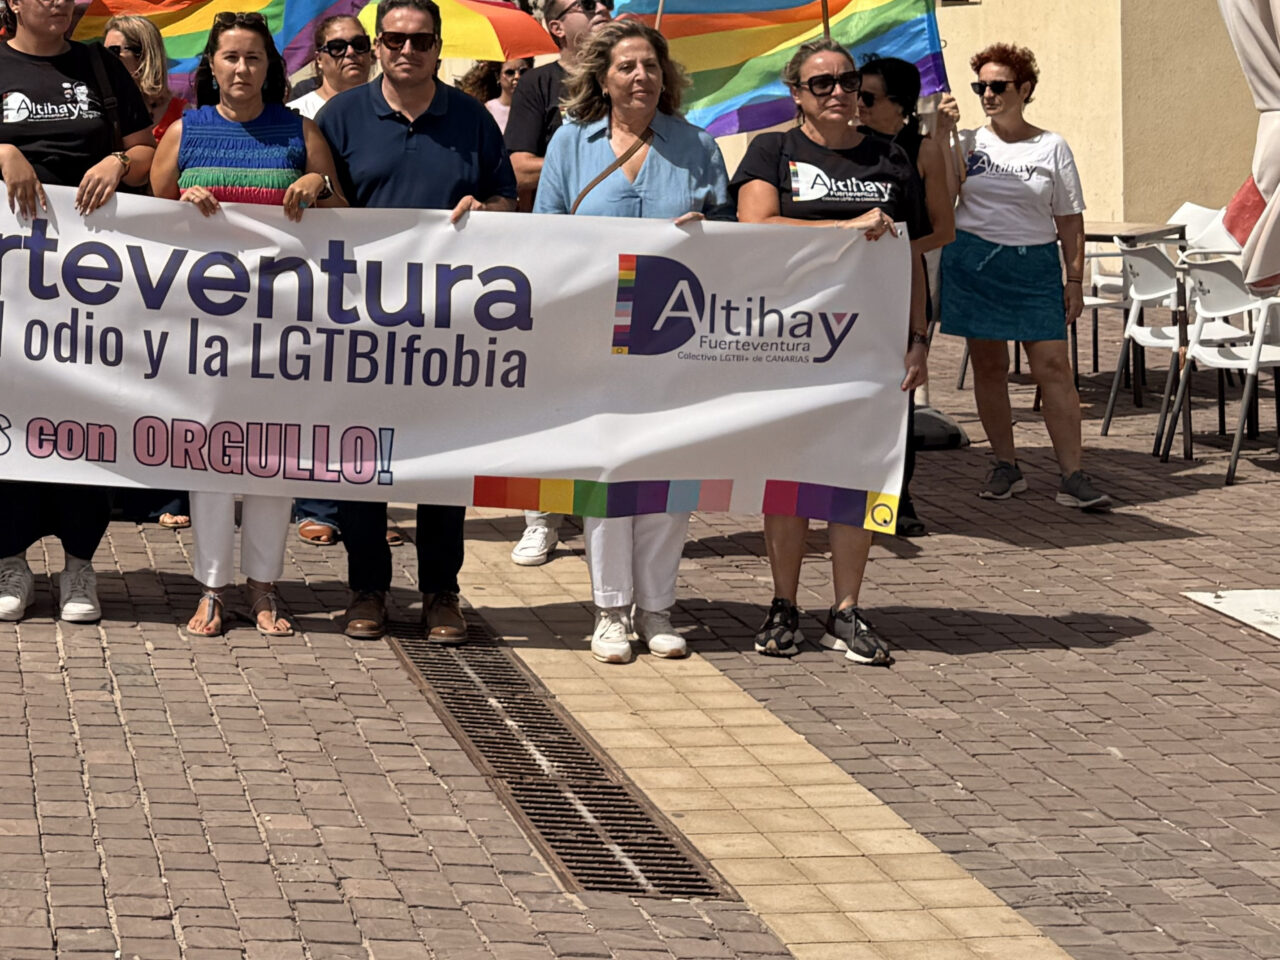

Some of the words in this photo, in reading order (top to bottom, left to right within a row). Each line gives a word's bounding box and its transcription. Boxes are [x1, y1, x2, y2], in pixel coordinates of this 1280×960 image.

[17, 99, 80, 119] Altihay
[810, 173, 892, 202] Altihay
[652, 280, 859, 363] Altihay
[24, 307, 124, 367] odio
[143, 330, 168, 379] y
[189, 318, 229, 378] la
[250, 322, 527, 388] LGTBIfobia
[677, 351, 717, 361] Colectivo
[752, 354, 763, 362] de
[765, 355, 810, 363] CANARIAS
[699, 335, 810, 352] Fuerteventura
[26, 417, 117, 463] con
[133, 415, 394, 485] ORGULLO!
